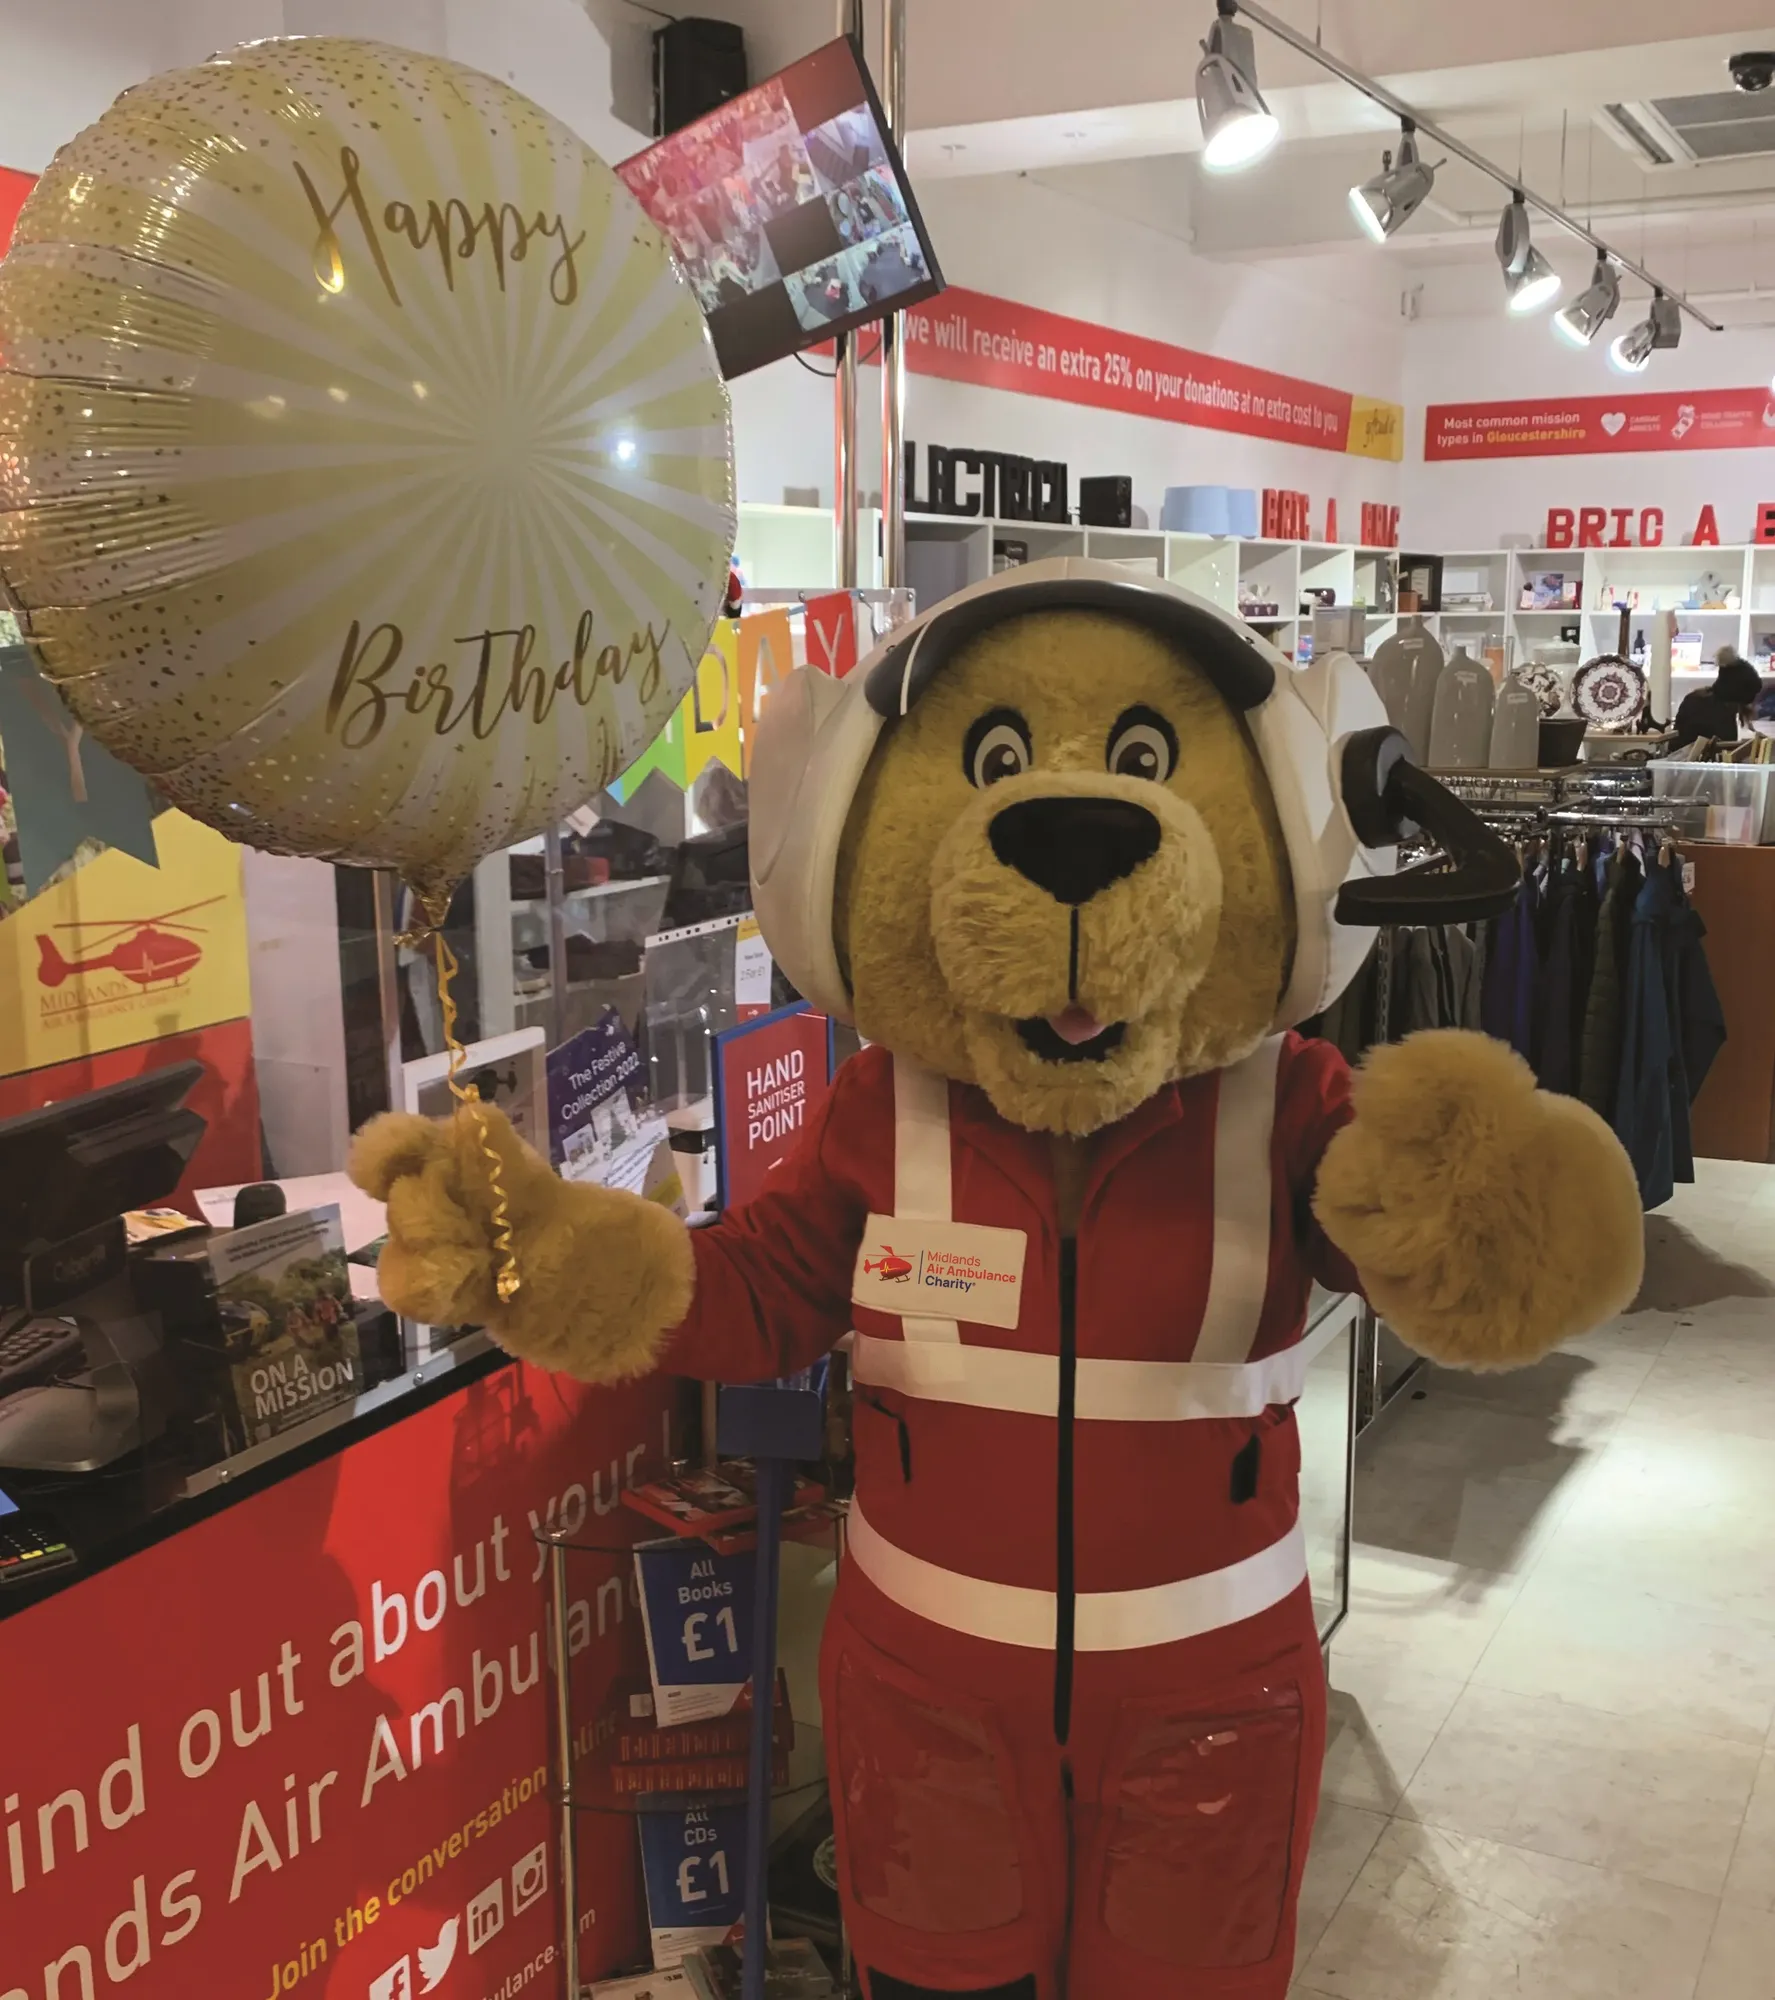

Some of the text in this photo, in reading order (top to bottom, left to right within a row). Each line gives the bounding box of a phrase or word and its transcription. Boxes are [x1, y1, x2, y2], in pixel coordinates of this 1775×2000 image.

[293, 146, 586, 307] Happy
[904, 311, 929, 345] we
[934, 314, 968, 352] will
[973, 328, 1034, 367] receive
[1037, 343, 1057, 372] an
[1060, 347, 1101, 382] extra
[1104, 352, 1133, 389] 25%
[1136, 371, 1153, 391] on
[1154, 374, 1184, 402] your
[1184, 371, 1240, 413] donations
[1240, 393, 1251, 413] at
[1252, 396, 1265, 418] no
[1267, 398, 1292, 422] extra
[1293, 404, 1313, 426] cost
[1314, 406, 1322, 428] to
[1323, 414, 1339, 437] you
[1437, 427, 1587, 448] types in Gloucestershire
[1444, 411, 1580, 430] Most common mission
[1546, 507, 1664, 548] BRIC
[1691, 504, 1720, 546] A
[325, 609, 671, 750] Birthday
[561, 1052, 641, 1120] Collection 2022
[568, 1041, 627, 1090] The Festive
[747, 1049, 805, 1099] HAND
[747, 1080, 806, 1120] SANITISER
[748, 1098, 807, 1150] POINT
[926, 1263, 1017, 1284] Air Ambulance
[927, 1250, 982, 1267] Midlands
[250, 1353, 310, 1395] ON A
[255, 1357, 356, 1420] MISSION
[677, 1580, 734, 1605] Books
[690, 1559, 716, 1580] All
[179, 1640, 305, 1779] out
[329, 1514, 512, 1688] about
[527, 1443, 647, 1584] your
[681, 1605, 739, 1663] £1
[684, 1827, 718, 1847] CDs
[0, 1869, 202, 2000] nds
[228, 1770, 339, 1904] Air
[265, 1938, 328, 2000] Join
[334, 1895, 381, 1948] the
[387, 1764, 548, 1906] conversation
[675, 1849, 730, 1903] £1
